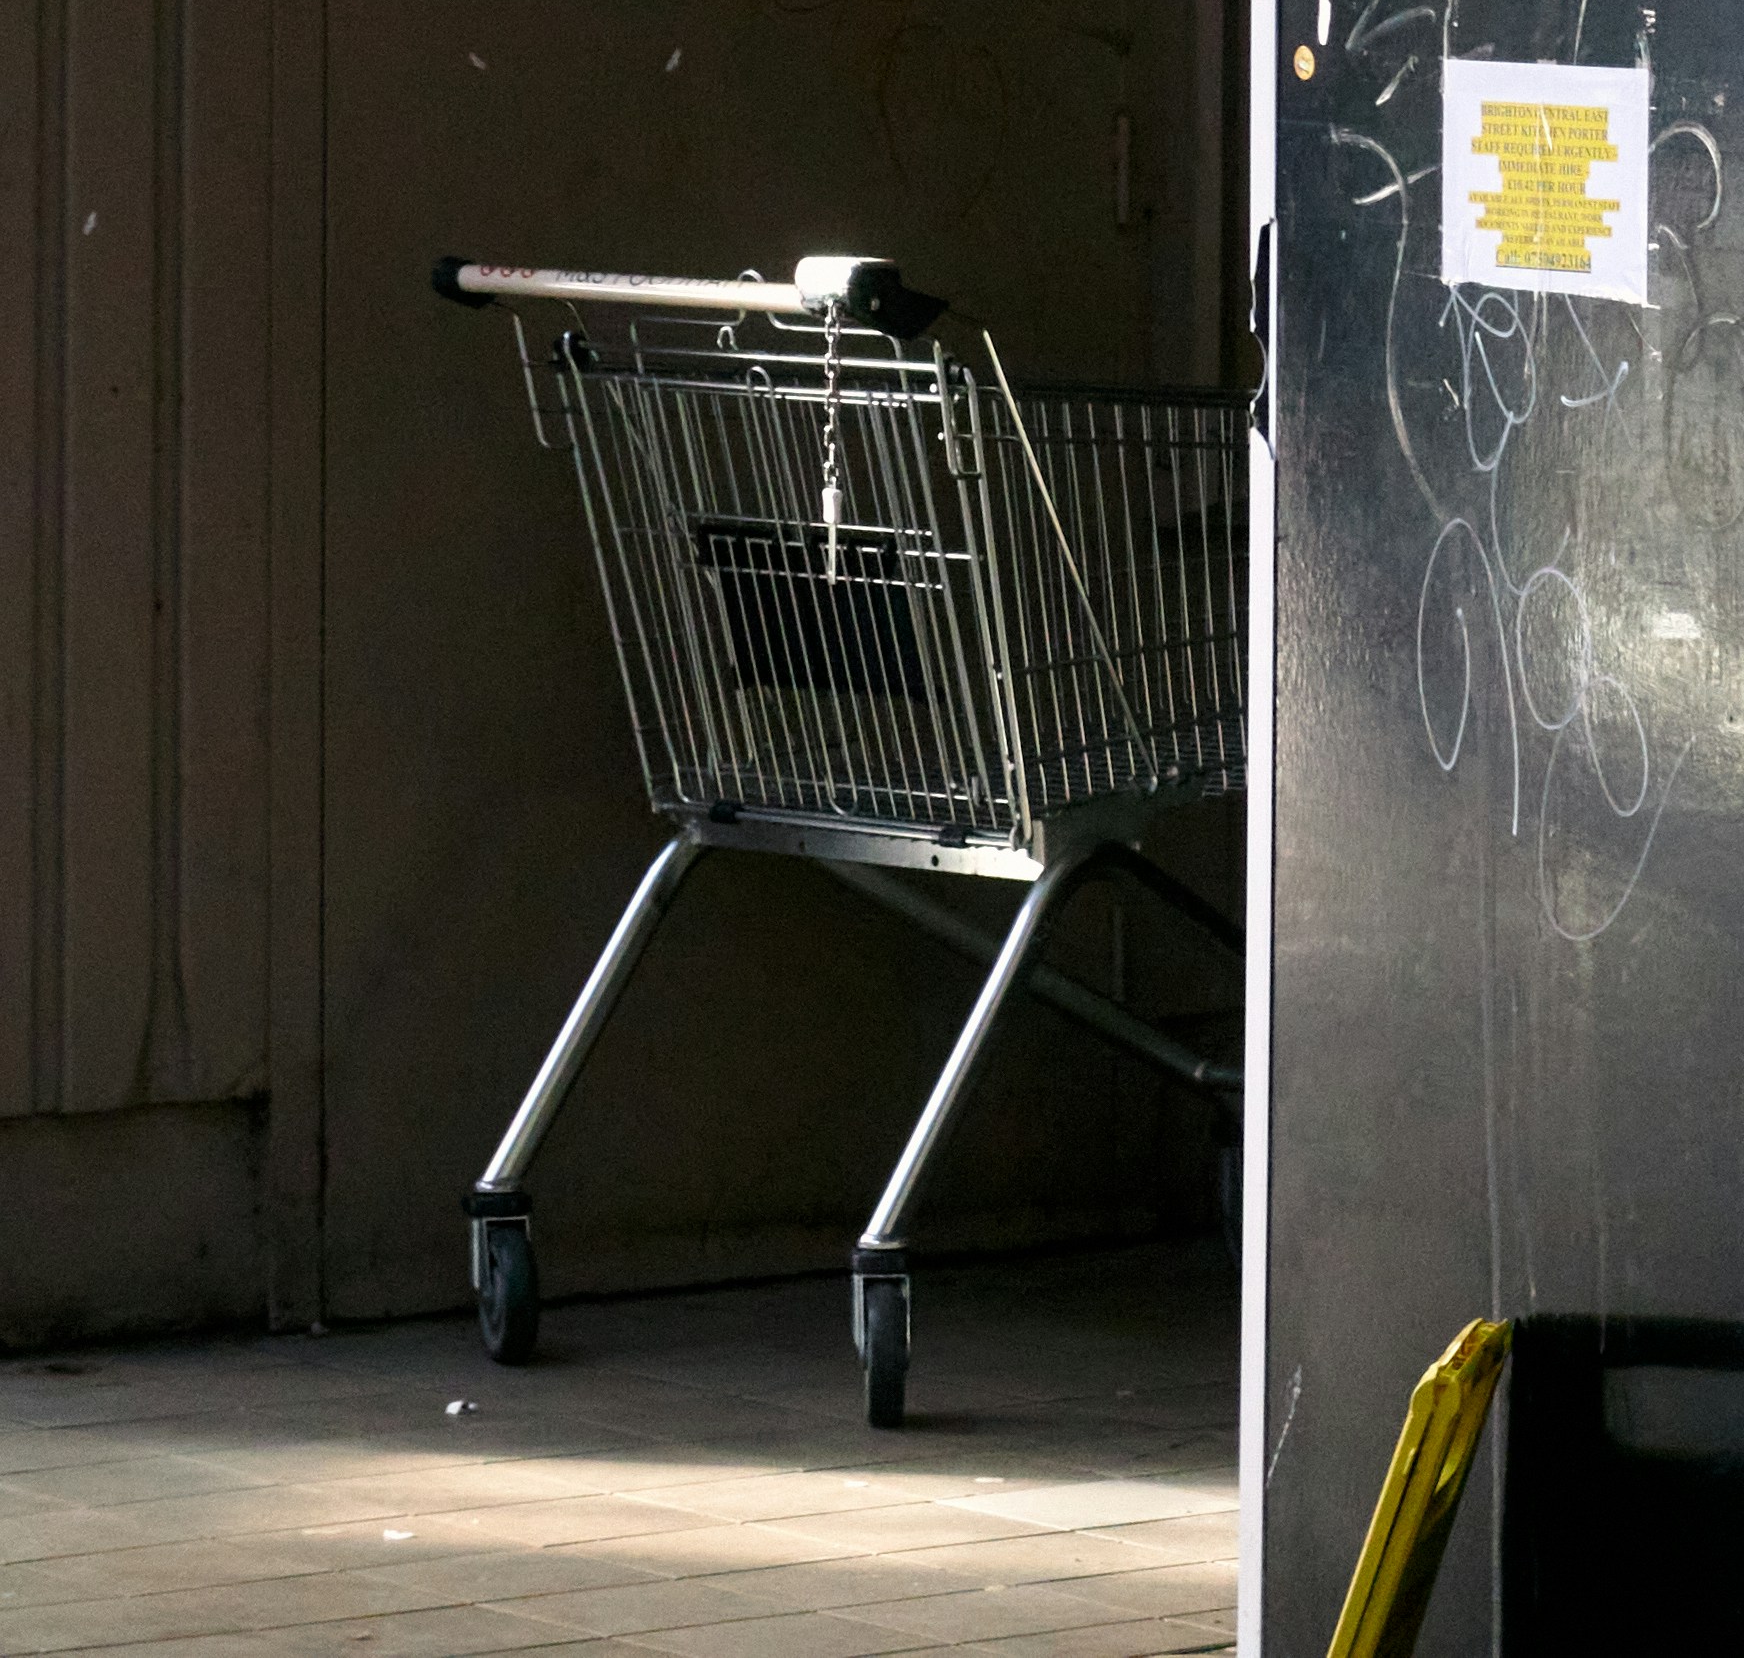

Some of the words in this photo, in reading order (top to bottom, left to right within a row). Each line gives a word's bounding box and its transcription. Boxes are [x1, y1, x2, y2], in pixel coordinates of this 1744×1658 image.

[1481, 104, 1533, 118] BRIGHTON
[1585, 110, 1609, 123] EAST
[1482, 122, 1518, 136] STREET
[1568, 127, 1609, 142] PORTER
[1471, 140, 1500, 153] STAFF
[1556, 146, 1611, 161] URGENTLY
[1498, 160, 1556, 175] IMMEDIATE
[1559, 163, 1582, 176] HIRE
[1536, 179, 1554, 192] PER
[1557, 181, 1586, 195] HOUR
